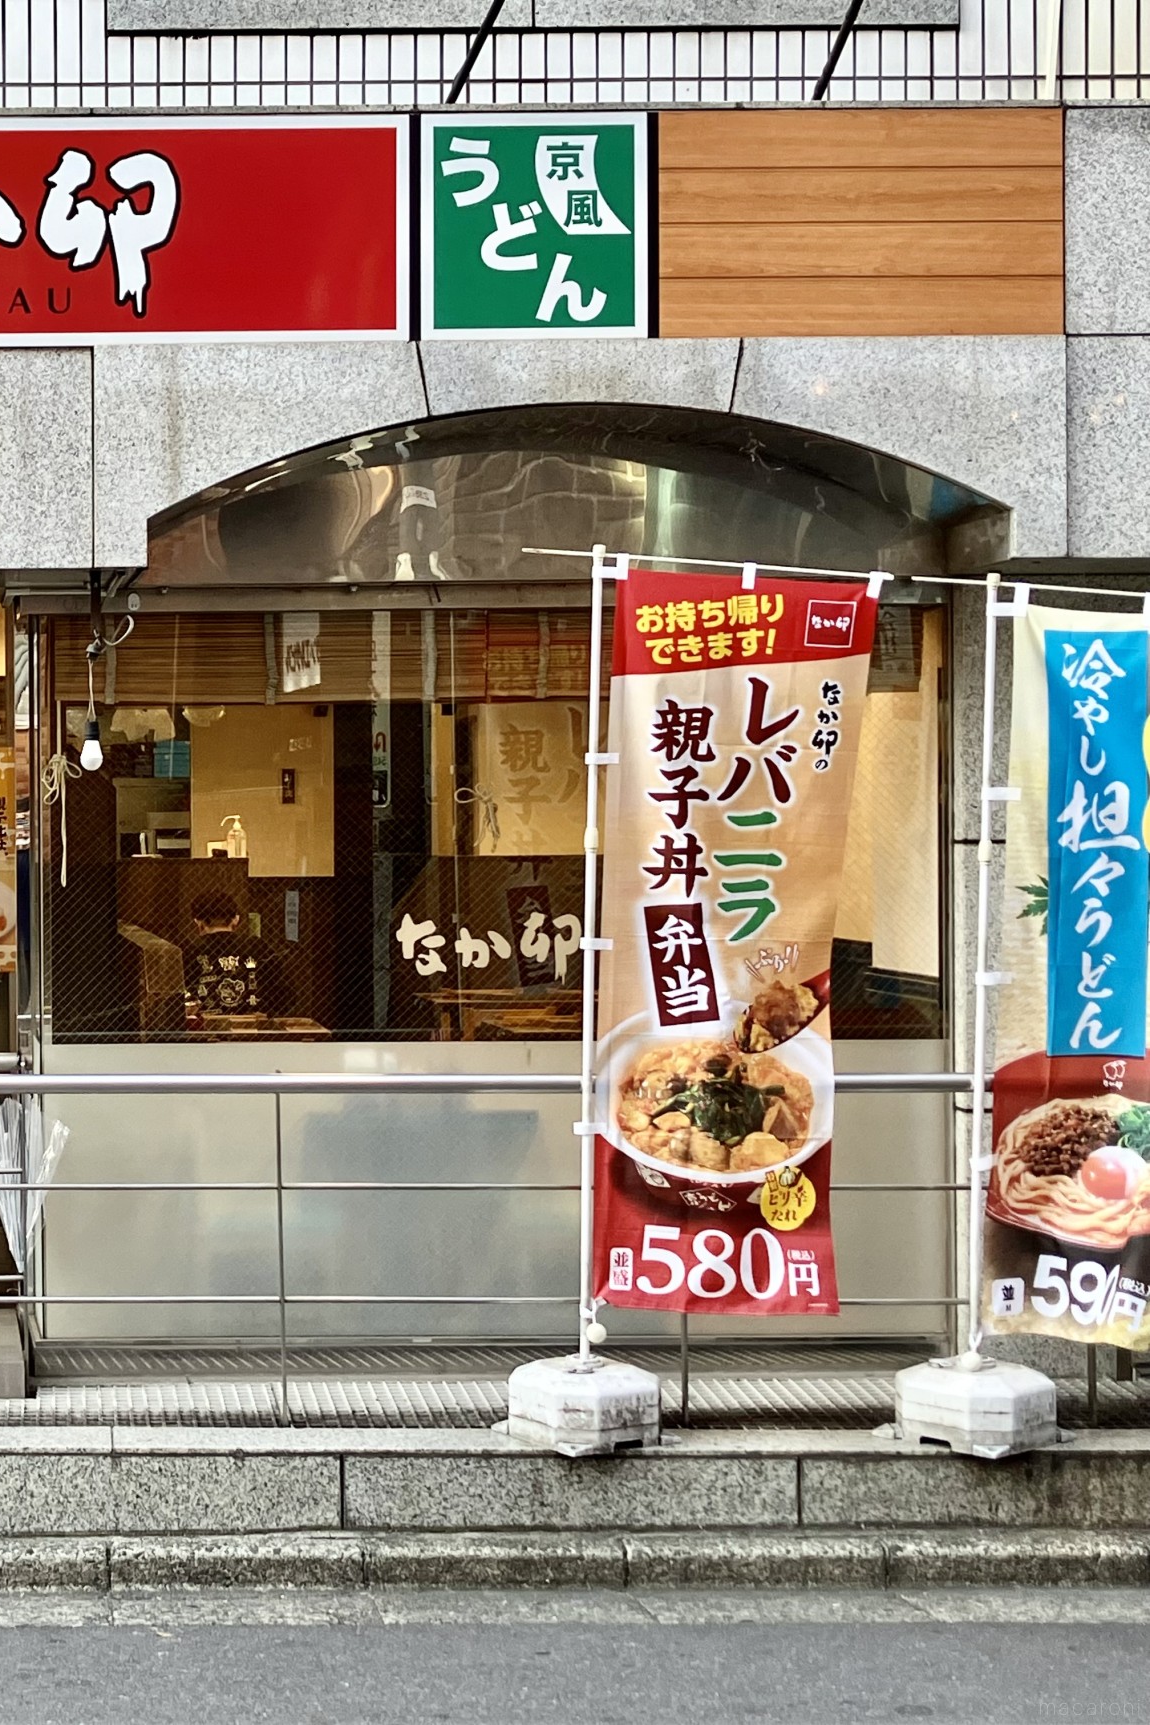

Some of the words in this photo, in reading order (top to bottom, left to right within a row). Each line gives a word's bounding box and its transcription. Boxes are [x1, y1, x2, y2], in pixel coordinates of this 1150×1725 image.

[546, 140, 603, 230] 京風
[440, 137, 608, 323] うどん
[635, 593, 785, 634] お持ち帰り
[645, 627, 777, 665] できます!
[811, 614, 851, 633] なか卯
[812, 681, 842, 771] なか卯の
[642, 698, 717, 899] 親子丼
[713, 676, 800, 942] レバニラ
[396, 911, 583, 983] なか卯
[652, 914, 710, 1018] 弁当
[770, 1209, 798, 1222] たれ
[613, 1251, 630, 1287] 並盛
[635, 1223, 821, 1301] 580円
[1001, 1284, 1016, 1302] 並
